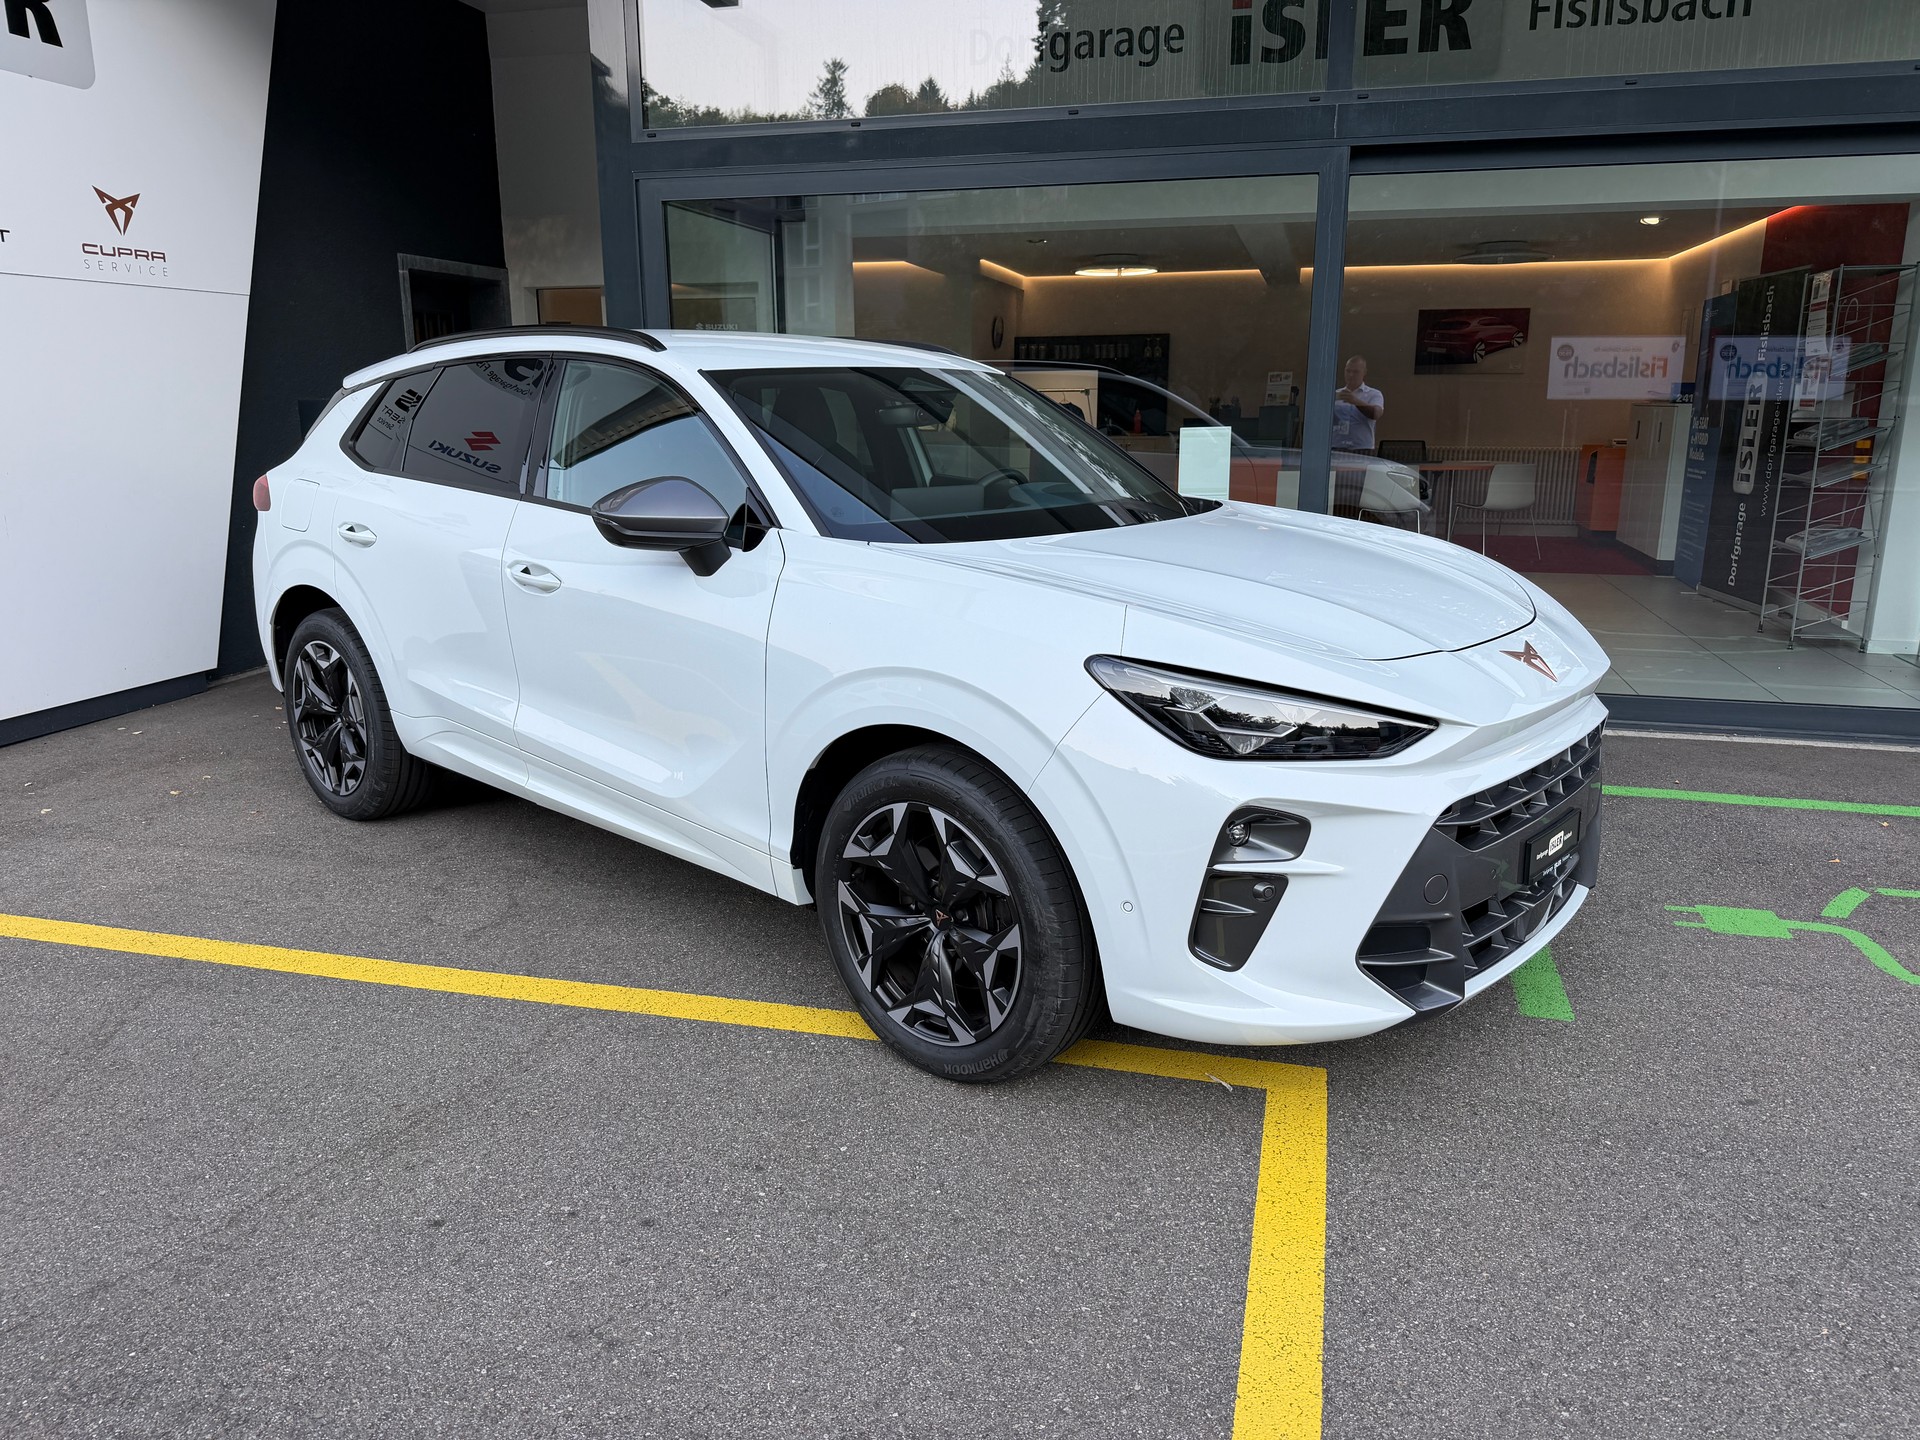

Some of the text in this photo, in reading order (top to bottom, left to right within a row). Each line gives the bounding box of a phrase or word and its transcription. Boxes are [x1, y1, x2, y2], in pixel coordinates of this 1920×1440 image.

[82, 242, 167, 263] CUPRA
[83, 259, 169, 277] SERVICE
[705, 323, 738, 331] SUZUKI
[1728, 285, 1775, 587] Dorfgarage iSLER Fislisbach
